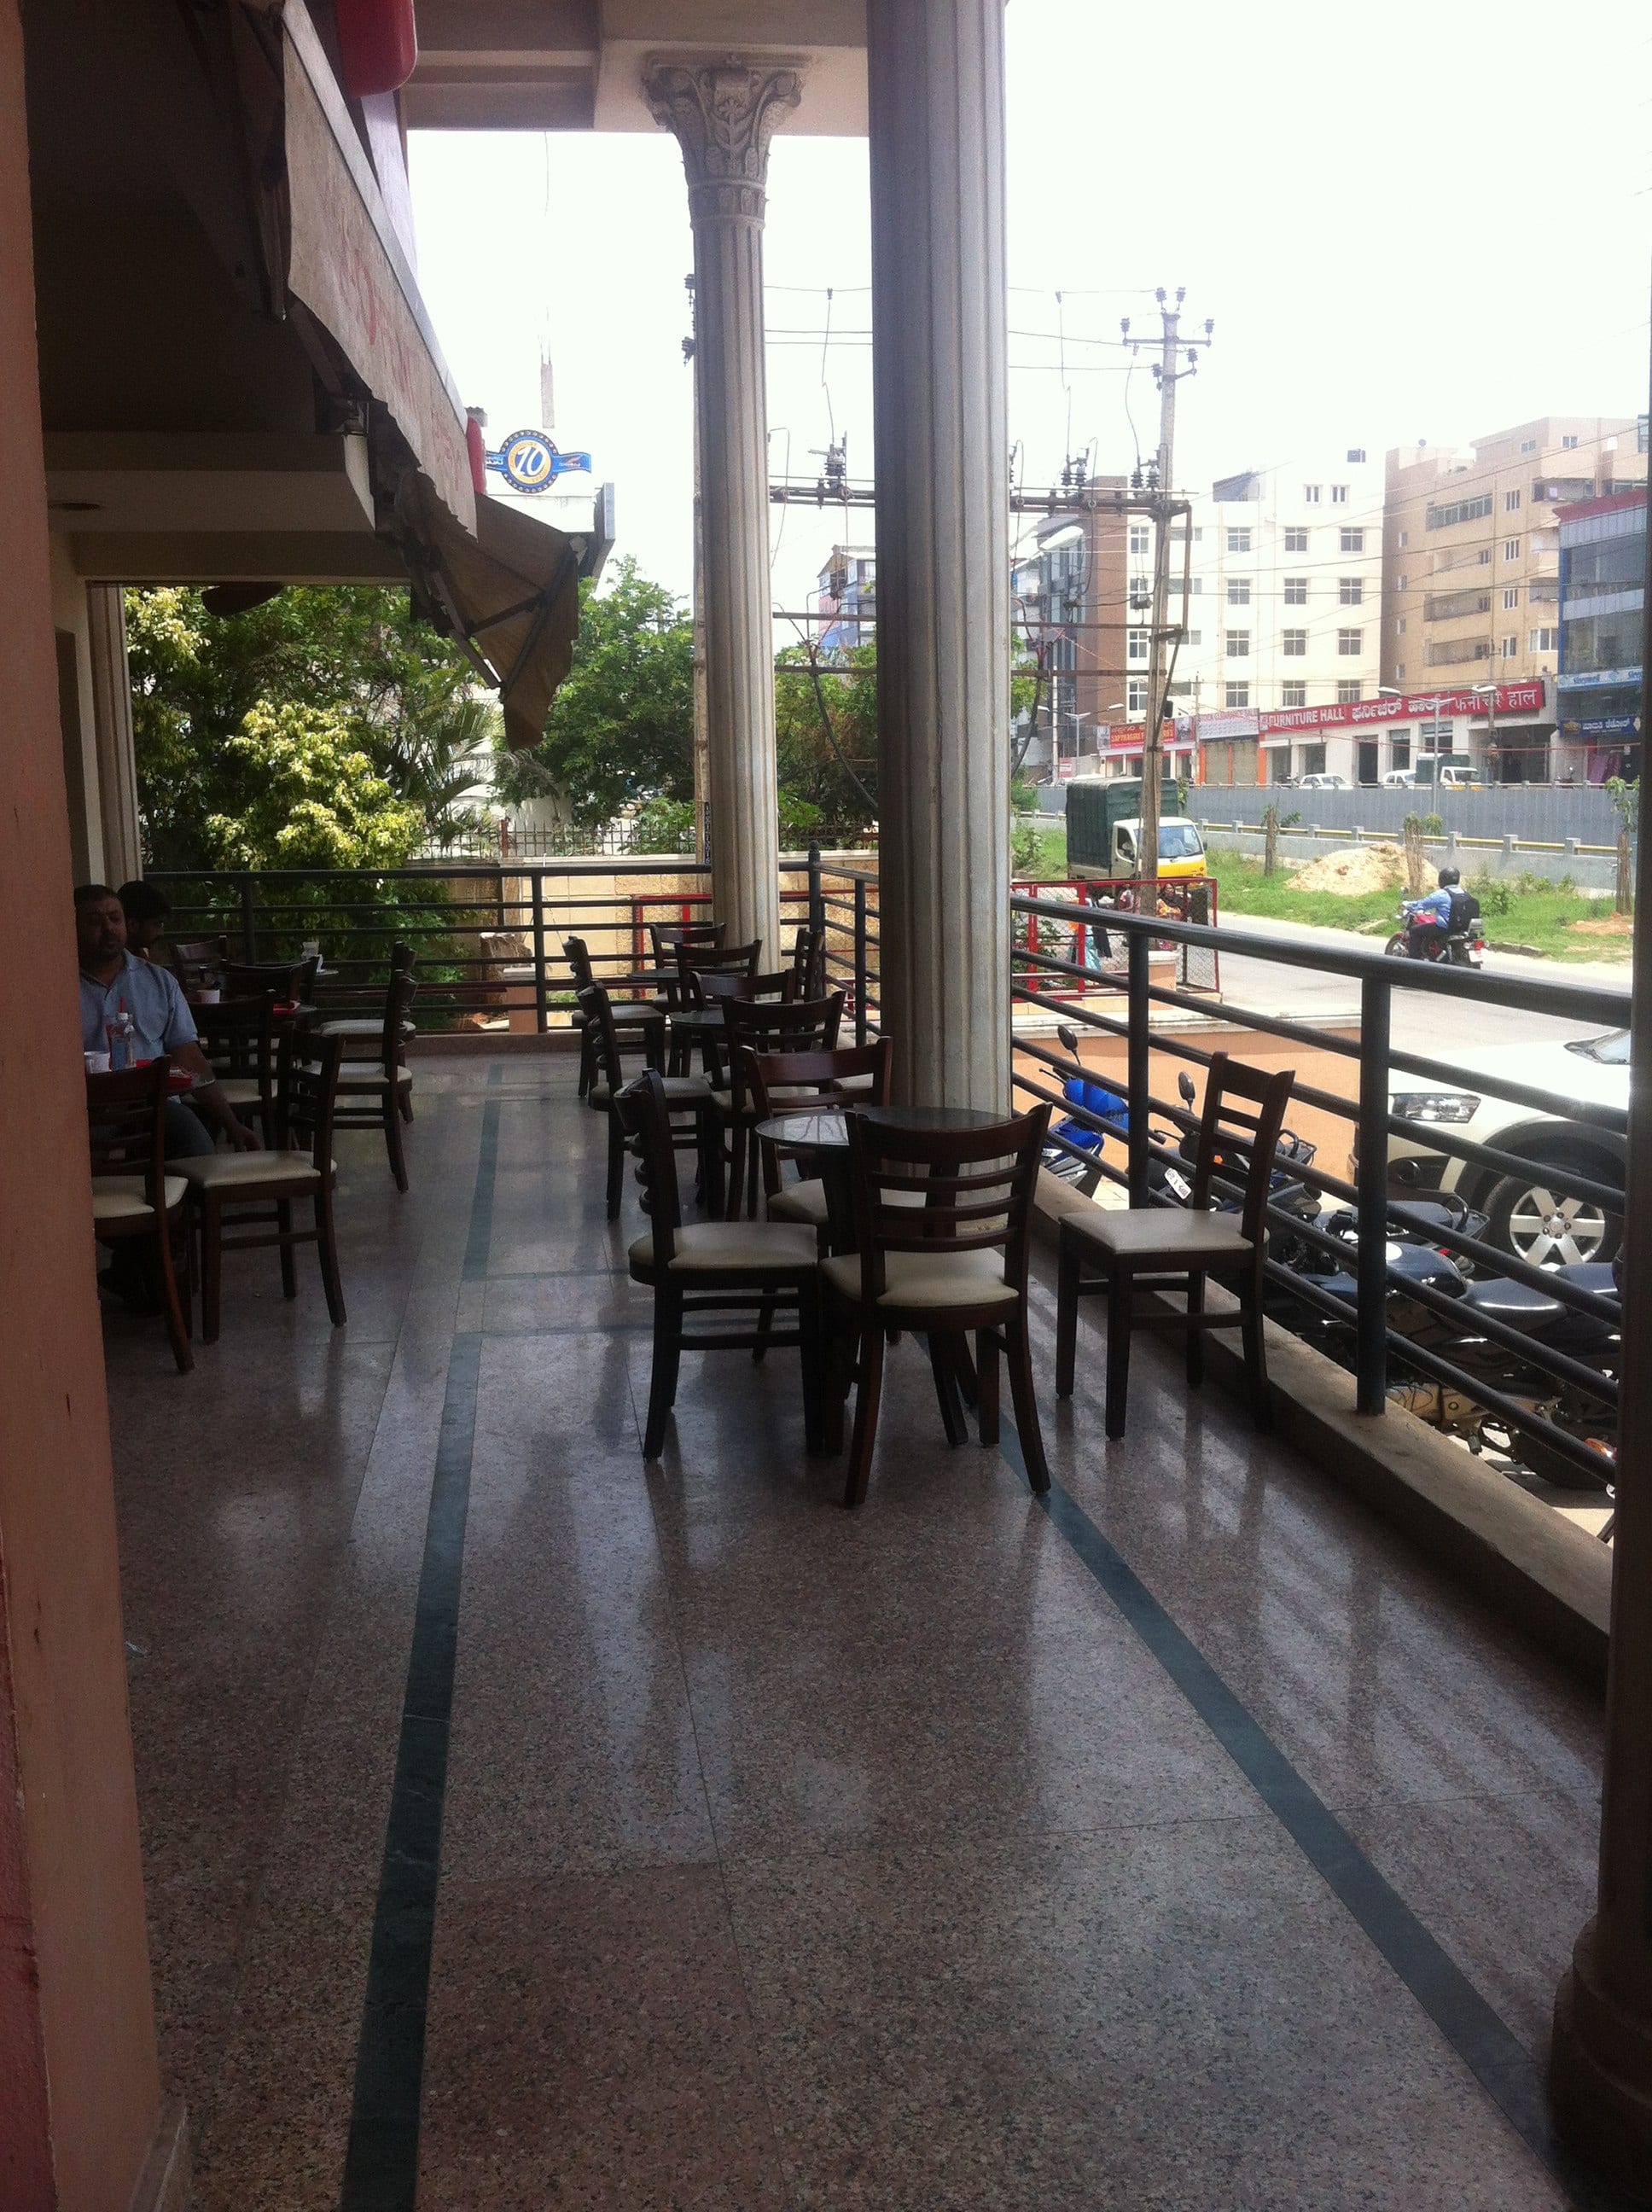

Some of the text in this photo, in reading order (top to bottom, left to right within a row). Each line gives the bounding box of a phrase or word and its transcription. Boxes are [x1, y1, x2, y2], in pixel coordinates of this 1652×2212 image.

[515, 445, 546, 477] 10
[1269, 707, 1345, 727] FURNITURE HALL
